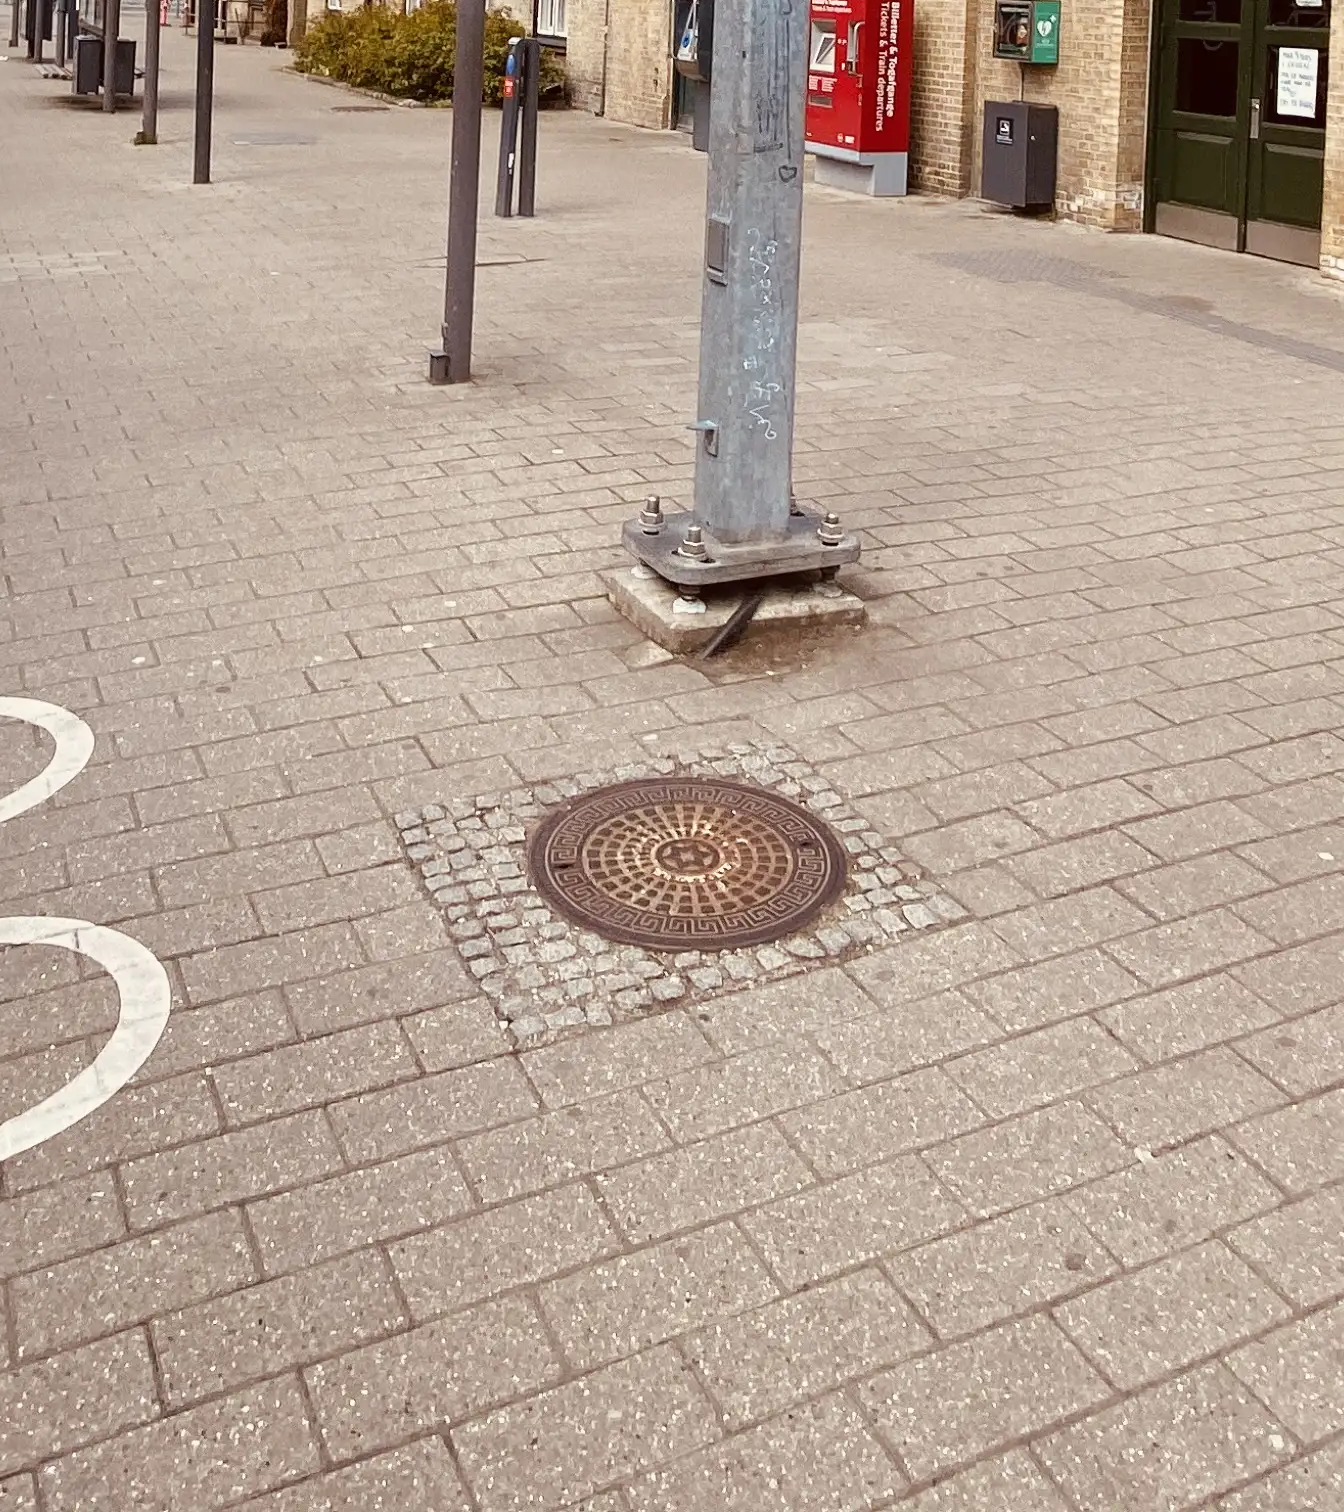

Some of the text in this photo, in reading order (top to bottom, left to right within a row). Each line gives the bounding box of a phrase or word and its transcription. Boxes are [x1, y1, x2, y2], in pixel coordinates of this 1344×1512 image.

[879, 1, 890, 39] Tickets
[877, 50, 888, 76] Train
[875, 77, 887, 132] departures
